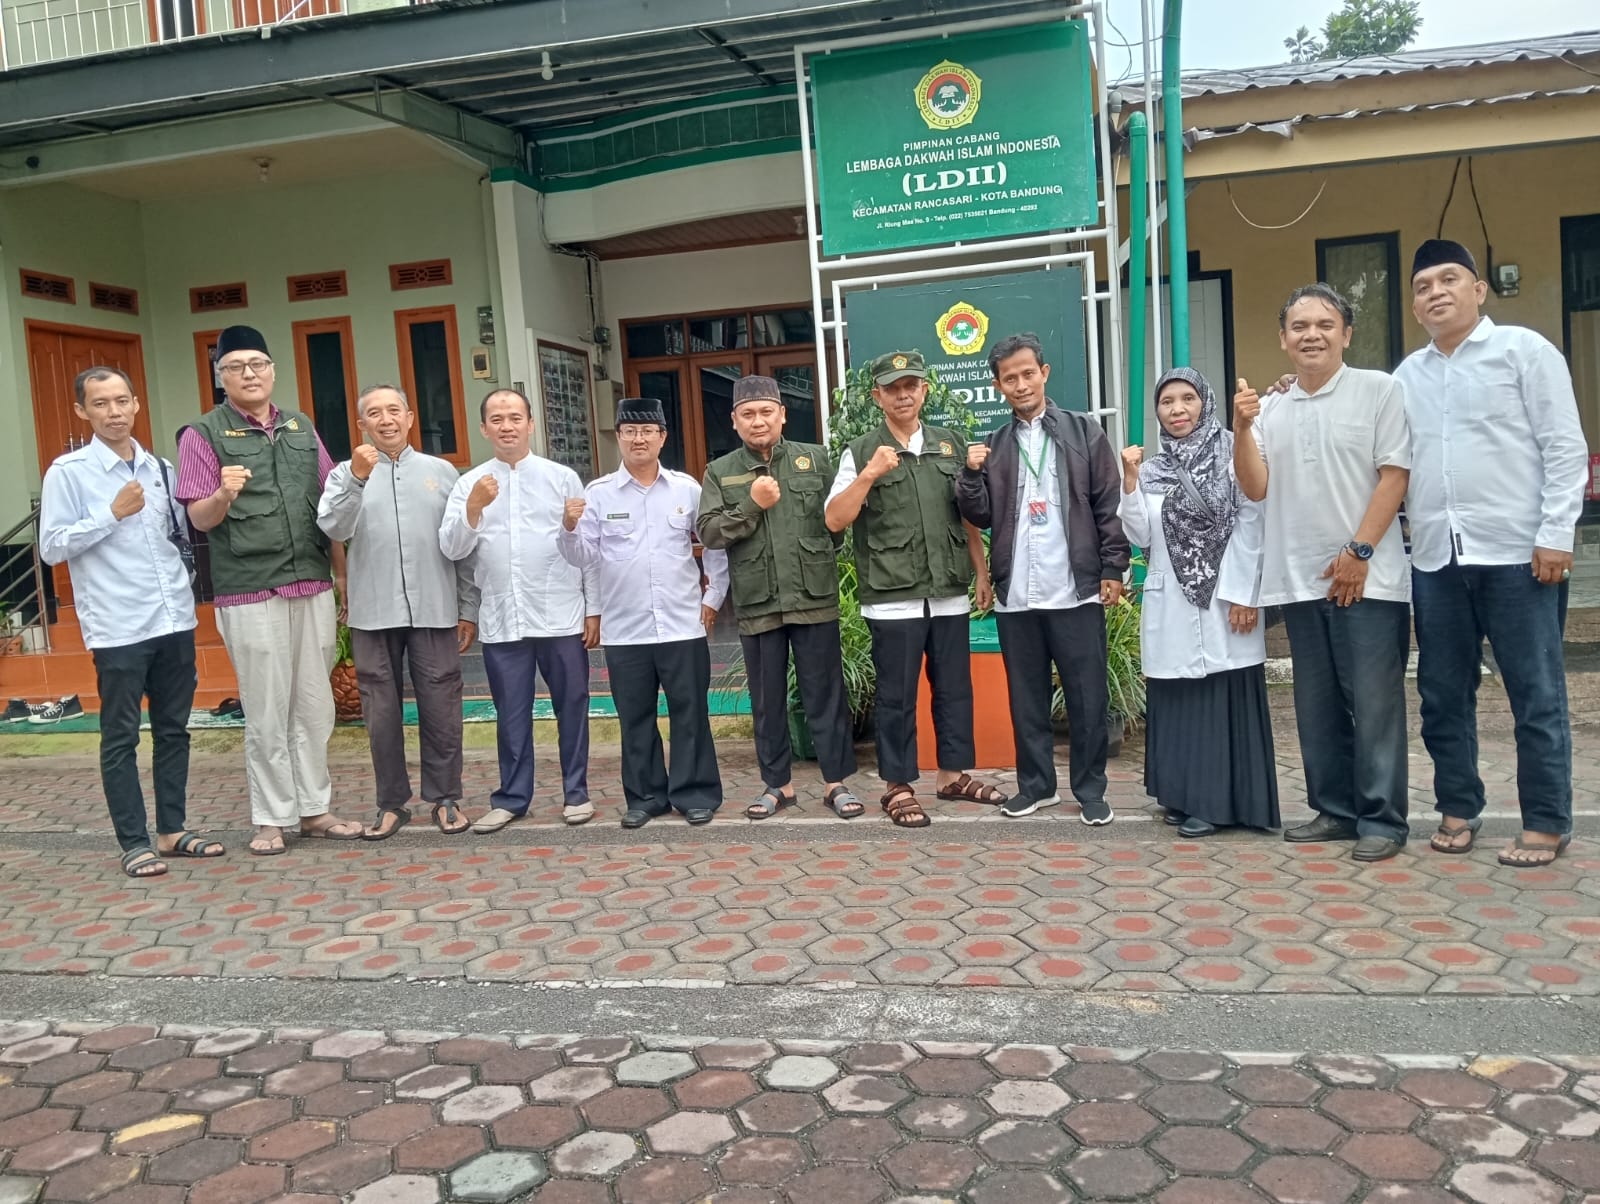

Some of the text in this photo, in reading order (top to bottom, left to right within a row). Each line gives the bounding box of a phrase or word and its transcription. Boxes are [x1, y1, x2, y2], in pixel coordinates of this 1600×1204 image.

[846, 136, 1061, 173] LEMBAGA DAKWAH ISLAM INDONESIA
[903, 132, 1000, 151] PIMPINAN CABANG
[902, 161, 1007, 196] (LDII)
[852, 202, 912, 218] KECAMATAN
[914, 194, 973, 209] RANCASARI
[980, 190, 1008, 201] KOTA
[1010, 185, 1061, 198] BANDUNG
[989, 207, 1016, 215] Bandung
[956, 360, 978, 369] ANAK
